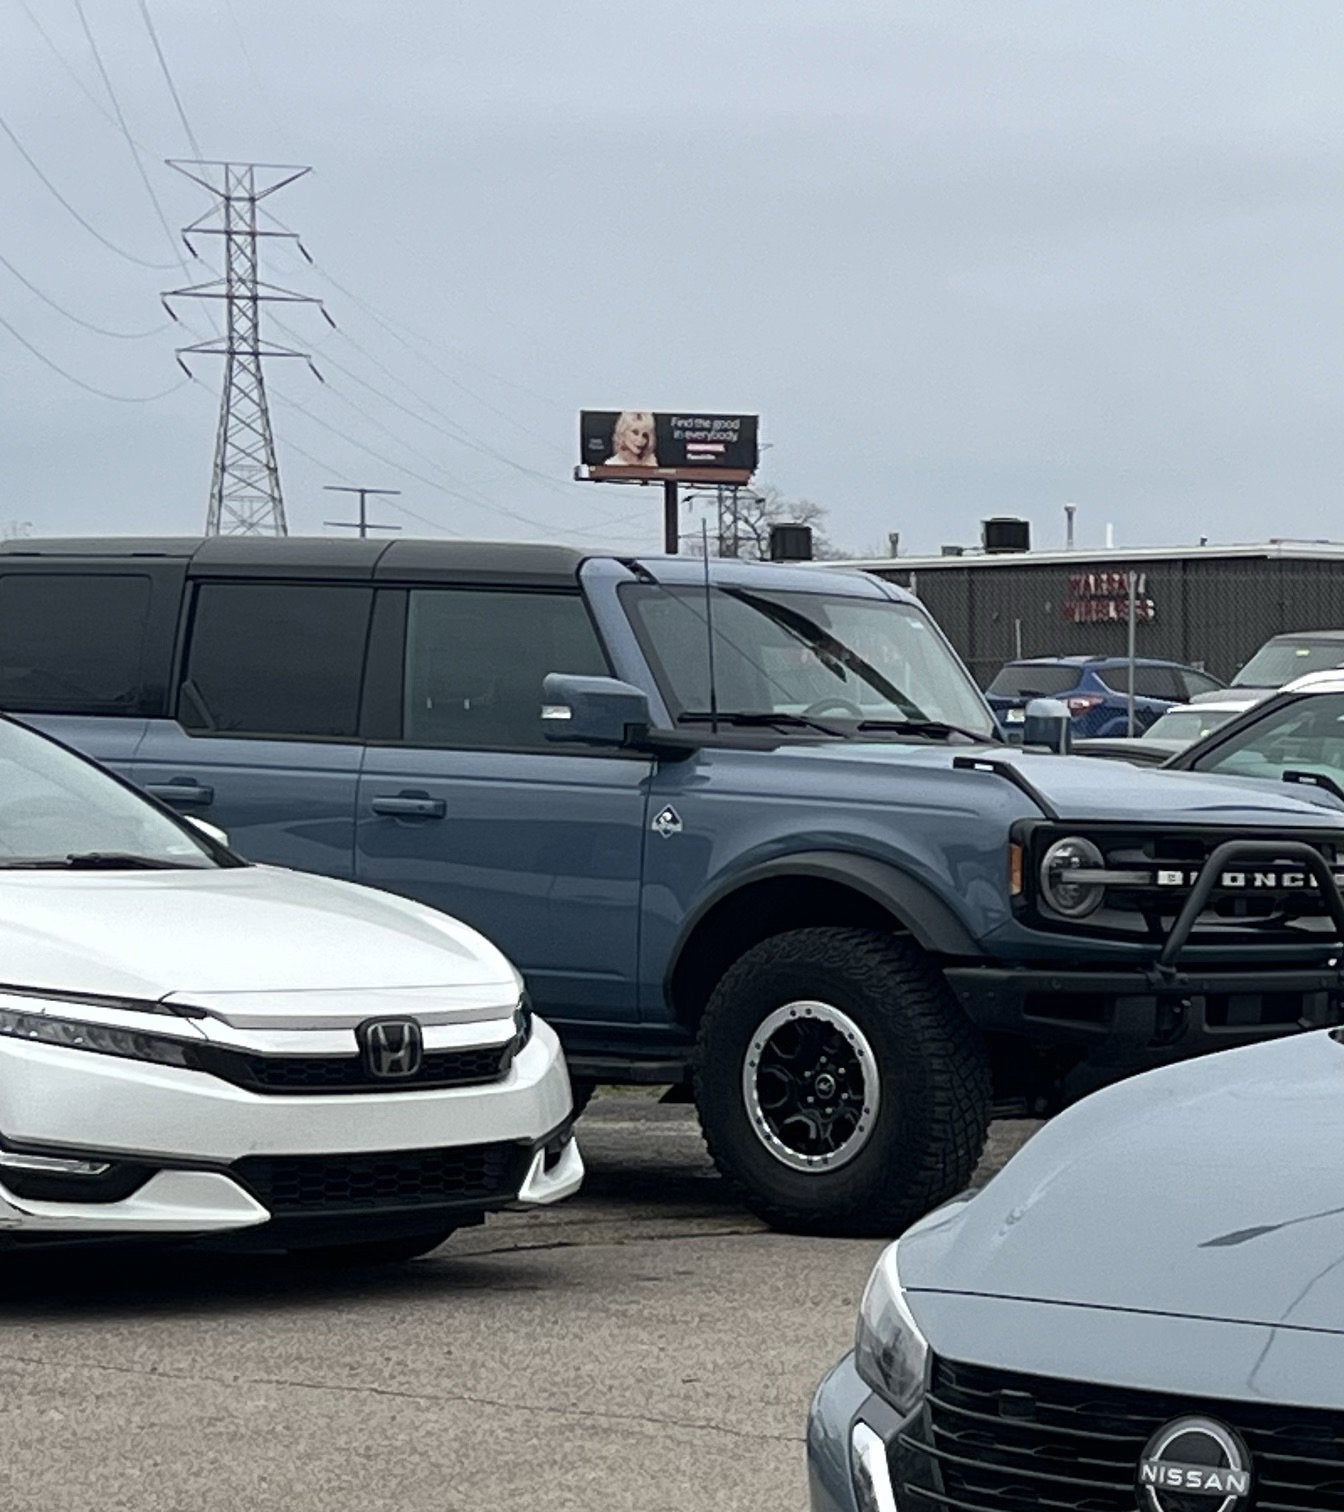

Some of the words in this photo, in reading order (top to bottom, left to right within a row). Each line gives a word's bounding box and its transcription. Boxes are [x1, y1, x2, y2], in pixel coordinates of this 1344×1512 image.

[671, 416, 693, 428] Find
[694, 418, 710, 428] the
[712, 418, 740, 431] good
[1141, 1464, 1246, 1492] NISSAN
